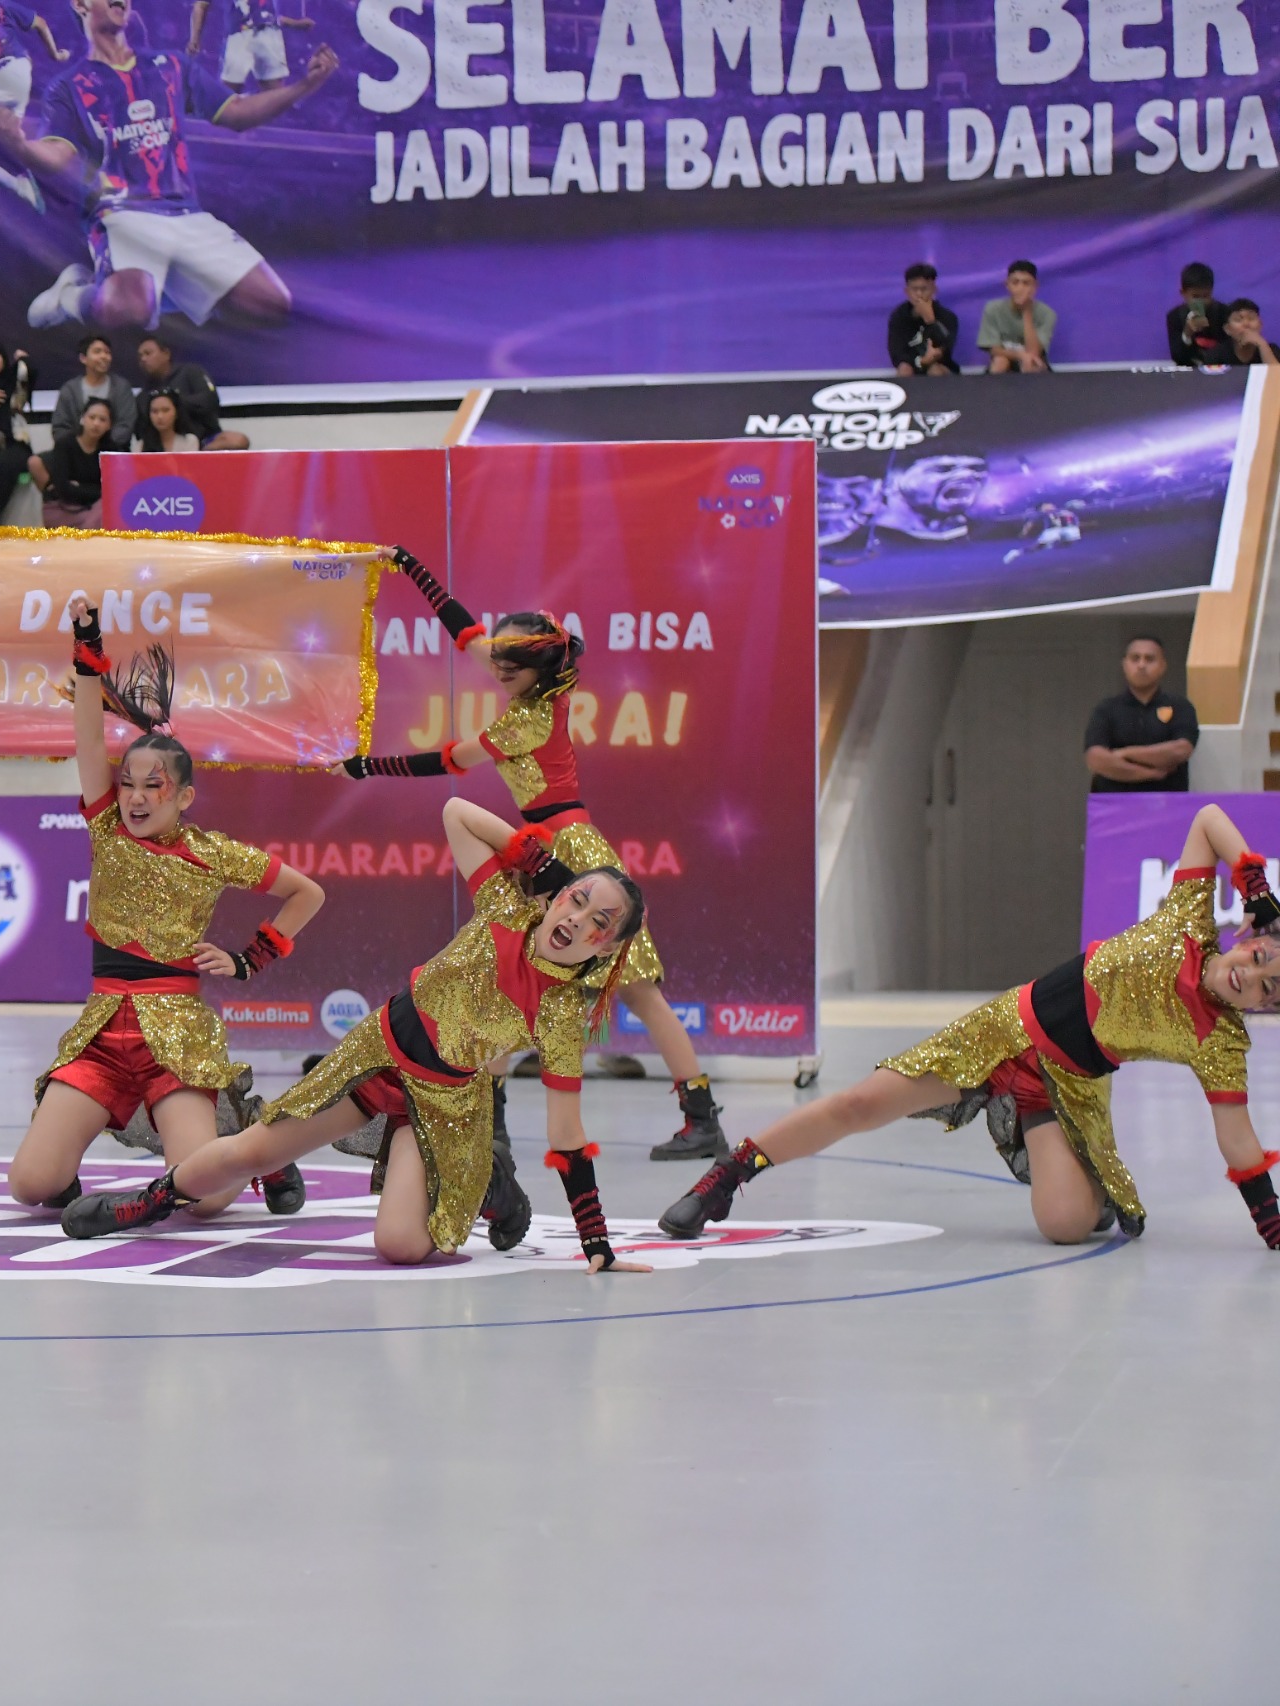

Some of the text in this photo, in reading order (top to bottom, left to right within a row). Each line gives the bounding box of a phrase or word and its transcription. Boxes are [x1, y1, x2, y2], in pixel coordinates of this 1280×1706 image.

[994, 0, 1258, 85] BER
[371, 95, 1279, 203] JADILAH BAGIAN DARI SUA
[825, 391, 892, 402] AXIS
[830, 430, 924, 450] CUP
[730, 473, 761, 484] AXIS
[132, 497, 194, 516] AXIS
[319, 570, 346, 580] CUP
[608, 611, 714, 651] BISA
[408, 692, 688, 749] JURA!
[223, 1007, 310, 1023] KukuBima
[328, 1003, 364, 1017] AQUA
[719, 1006, 799, 1034] Vidio
